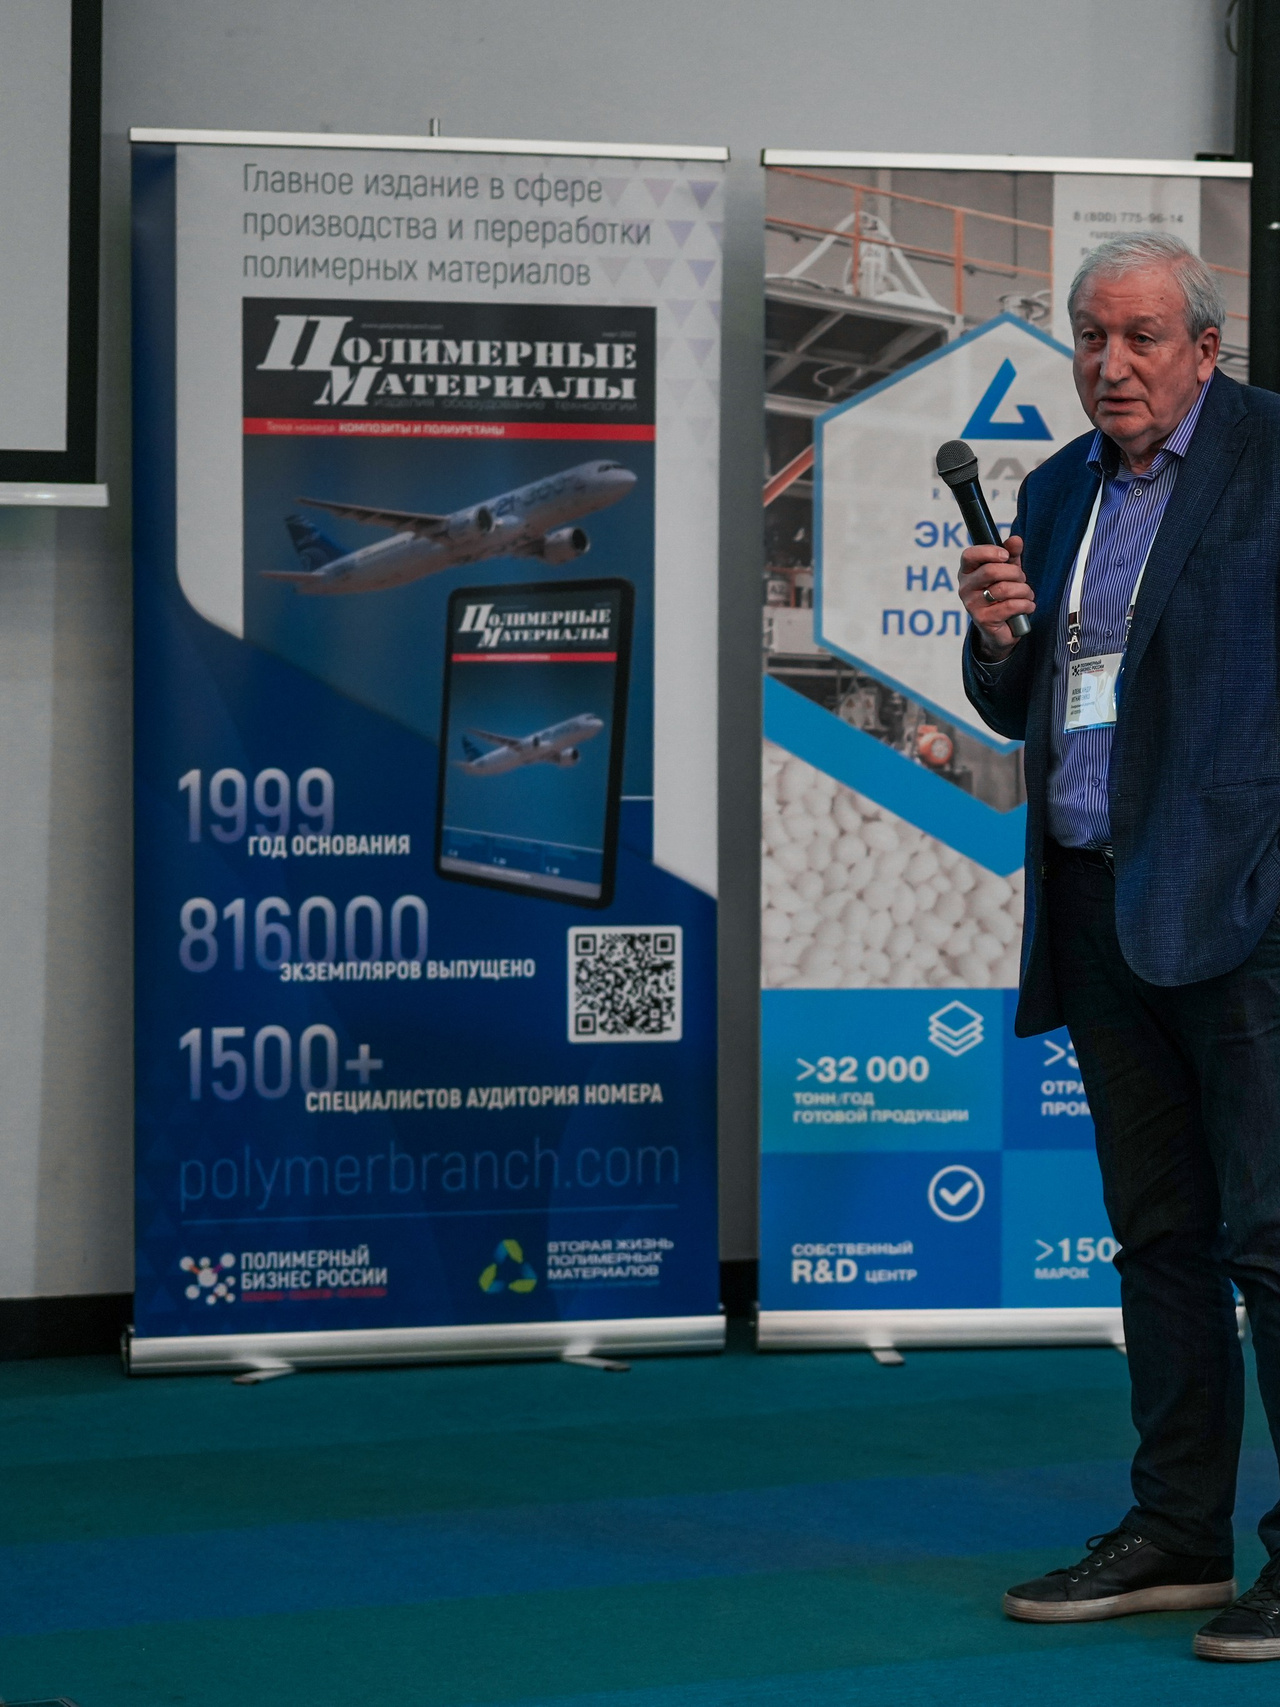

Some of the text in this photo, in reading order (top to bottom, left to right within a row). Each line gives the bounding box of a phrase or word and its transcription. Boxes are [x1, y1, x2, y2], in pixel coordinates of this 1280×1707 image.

[243, 163, 602, 207] Главное издание в сфере
[243, 212, 651, 249] производства и переработки
[243, 255, 591, 289] полимерных материалов
[256, 314, 637, 371] ПОЛИМЕРНЫЕ
[313, 366, 637, 406] МАТЕРИАЛЫ
[906, 565, 954, 592] НА
[178, 767, 335, 844] 1999
[248, 834, 411, 858] ГОД ОСНОВАНИЯ
[179, 895, 429, 973] 816000
[280, 958, 536, 982] ЭКЗЕМПЛЯРОВ ВЫПУЩЕНО
[179, 1024, 383, 1100] 1500+
[796, 1055, 930, 1083] >32 000
[306, 1083, 663, 1113] СПЕЦИАЛИСТОВ АУДИТОРИЯ НОМЕРА
[793, 1108, 969, 1125] ГОТОВОЙ ПРОДУКЦИИ
[180, 1137, 679, 1213] polymerbranch.com
[241, 1244, 369, 1270] ПОЛИМЕРНЫЙ
[547, 1238, 674, 1253] ВТОРАЯ ЖИЗНЬ
[792, 1240, 914, 1256] СОБСТВЕННЫЙ
[547, 1252, 663, 1267] ПОЛИМЕРНЫХ
[547, 1264, 660, 1280] МАТЕРИАЛОВ
[791, 1258, 918, 1285] R&D ЦЕНТР
[1034, 1266, 1090, 1279] МАРОК
[241, 1268, 388, 1290] БИЗНЕС РОССИИ
